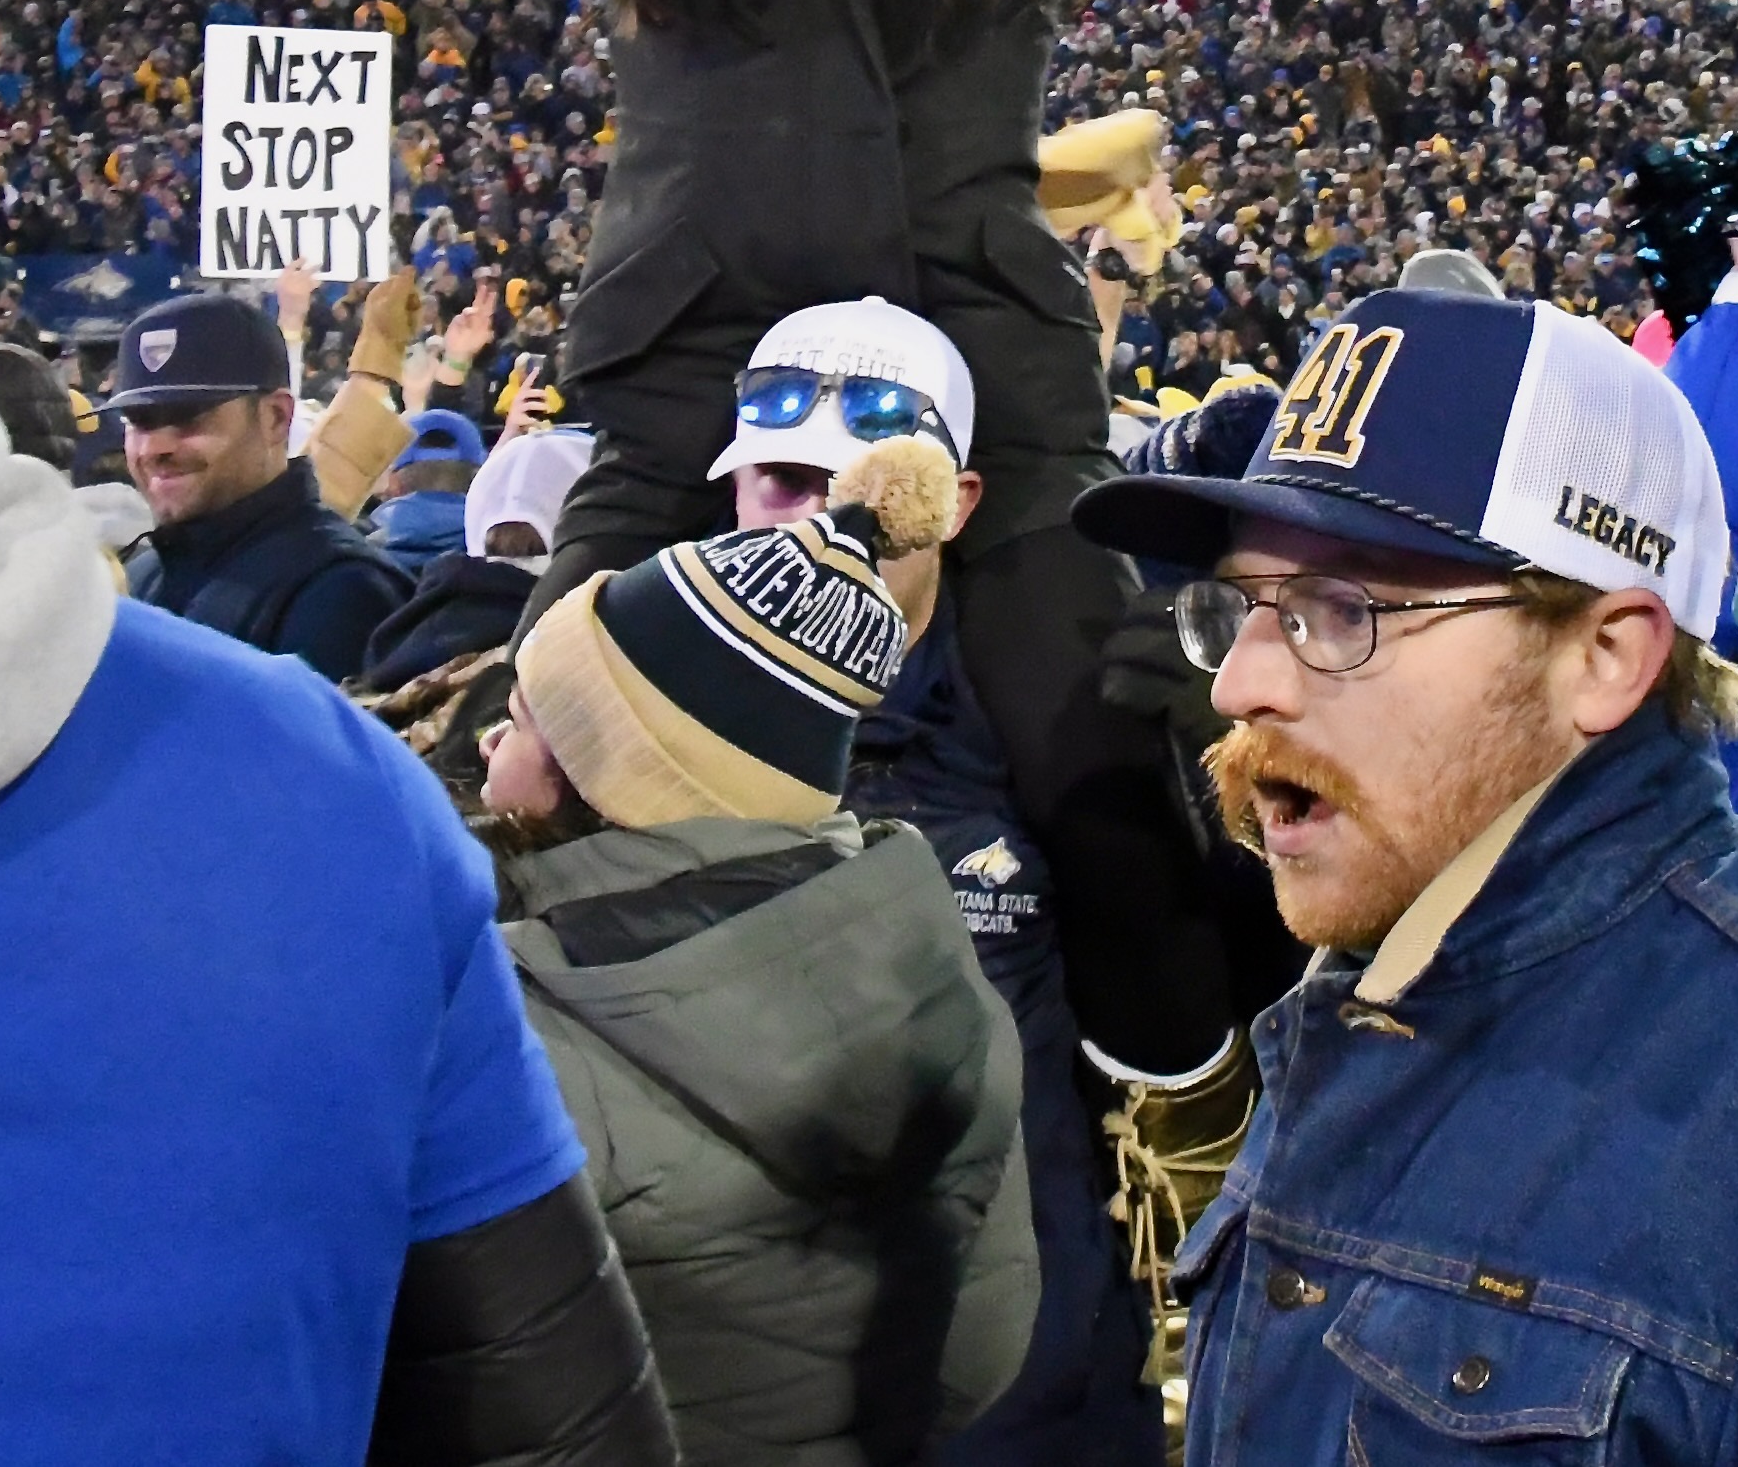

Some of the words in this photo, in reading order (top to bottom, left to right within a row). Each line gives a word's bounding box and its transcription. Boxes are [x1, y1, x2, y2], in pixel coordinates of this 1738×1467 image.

[244, 35, 377, 105] NEXT
[221, 120, 354, 192] STOP
[215, 204, 381, 280] NATTY
[1268, 322, 1405, 469] 41
[1553, 485, 1676, 578] LEGACY
[770, 571, 908, 688] MONTAN
